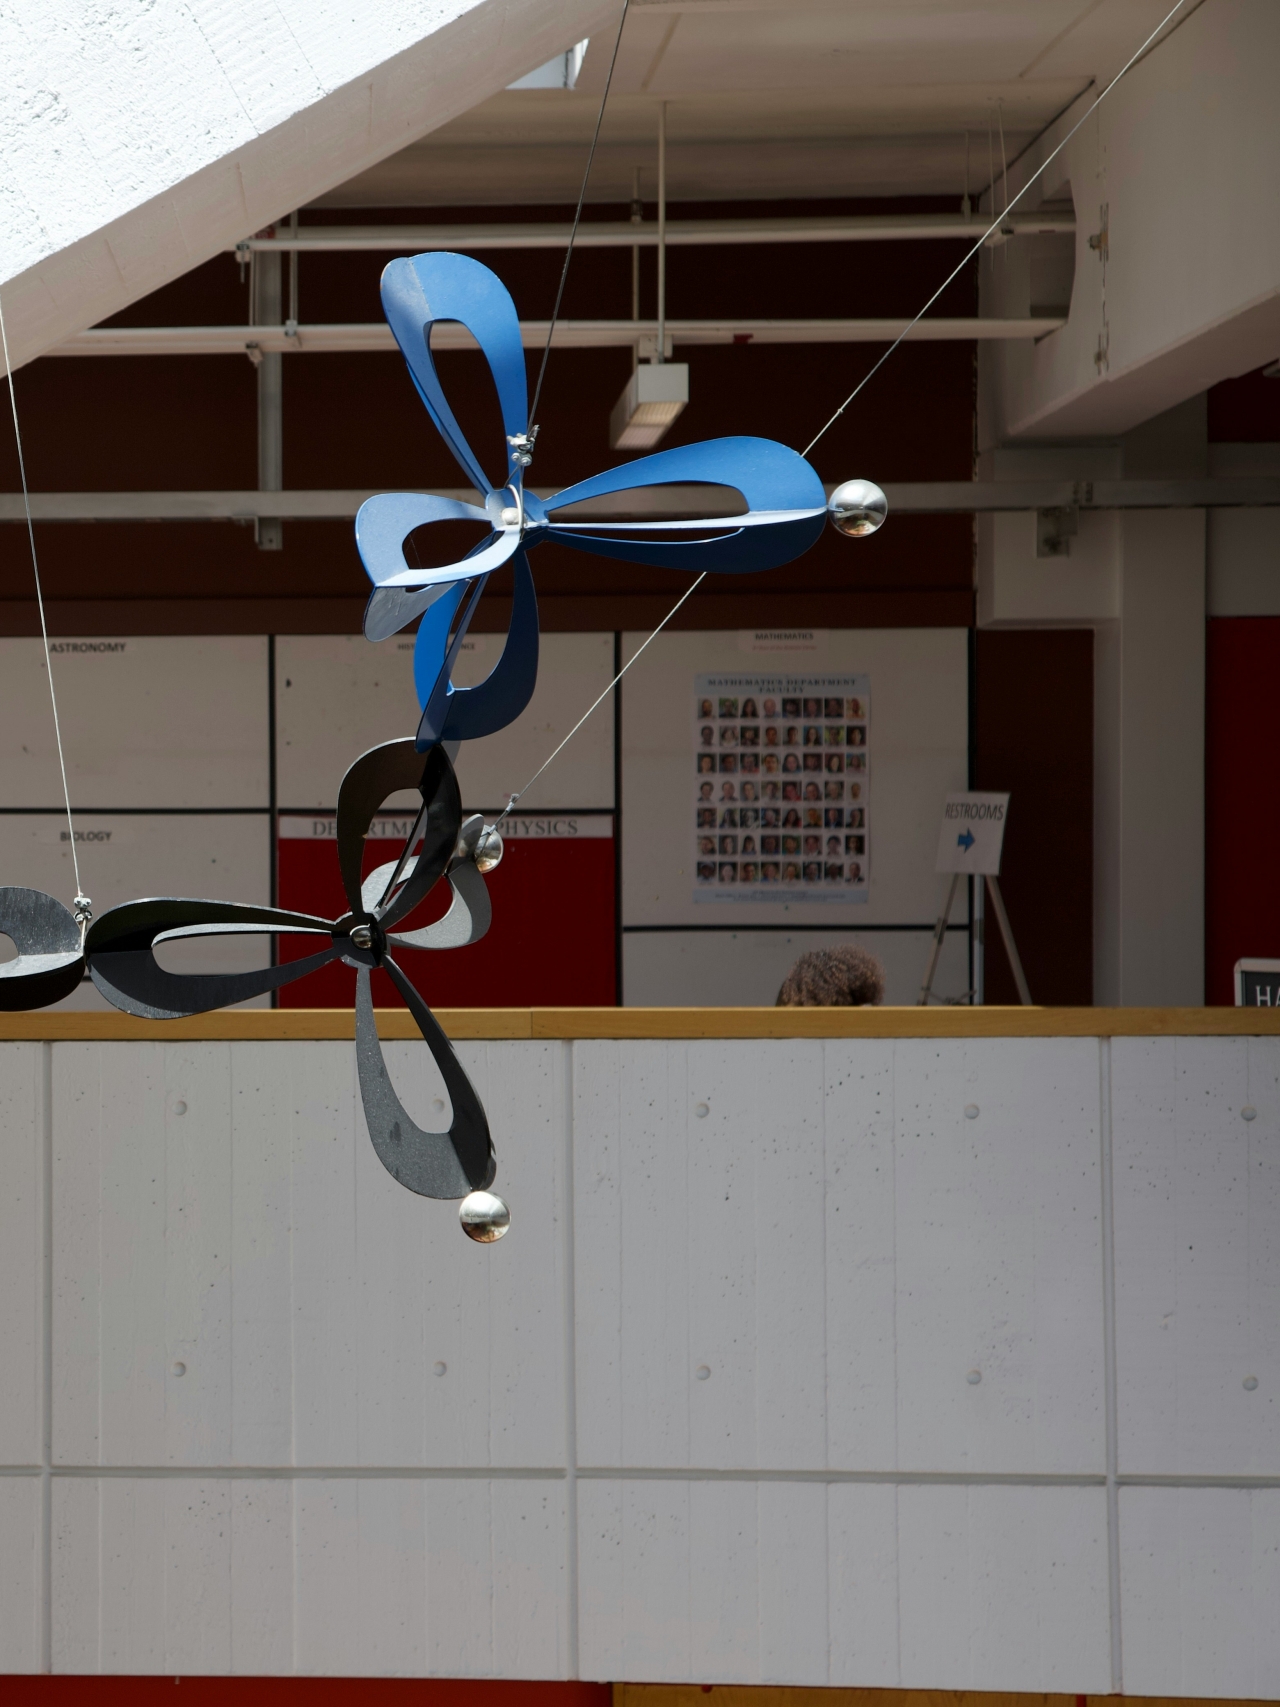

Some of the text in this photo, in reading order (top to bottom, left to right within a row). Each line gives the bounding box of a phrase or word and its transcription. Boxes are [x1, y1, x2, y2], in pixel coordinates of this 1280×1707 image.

[754, 632, 814, 642] MATHEMATICS
[50, 642, 127, 653] ASTRONOMY
[707, 678, 856, 687] MATHEMATICS DEPARTMENT
[759, 686, 805, 694] FACULTY
[945, 803, 1005, 821] RESTROOMS
[60, 830, 112, 842] BIOLOGY
